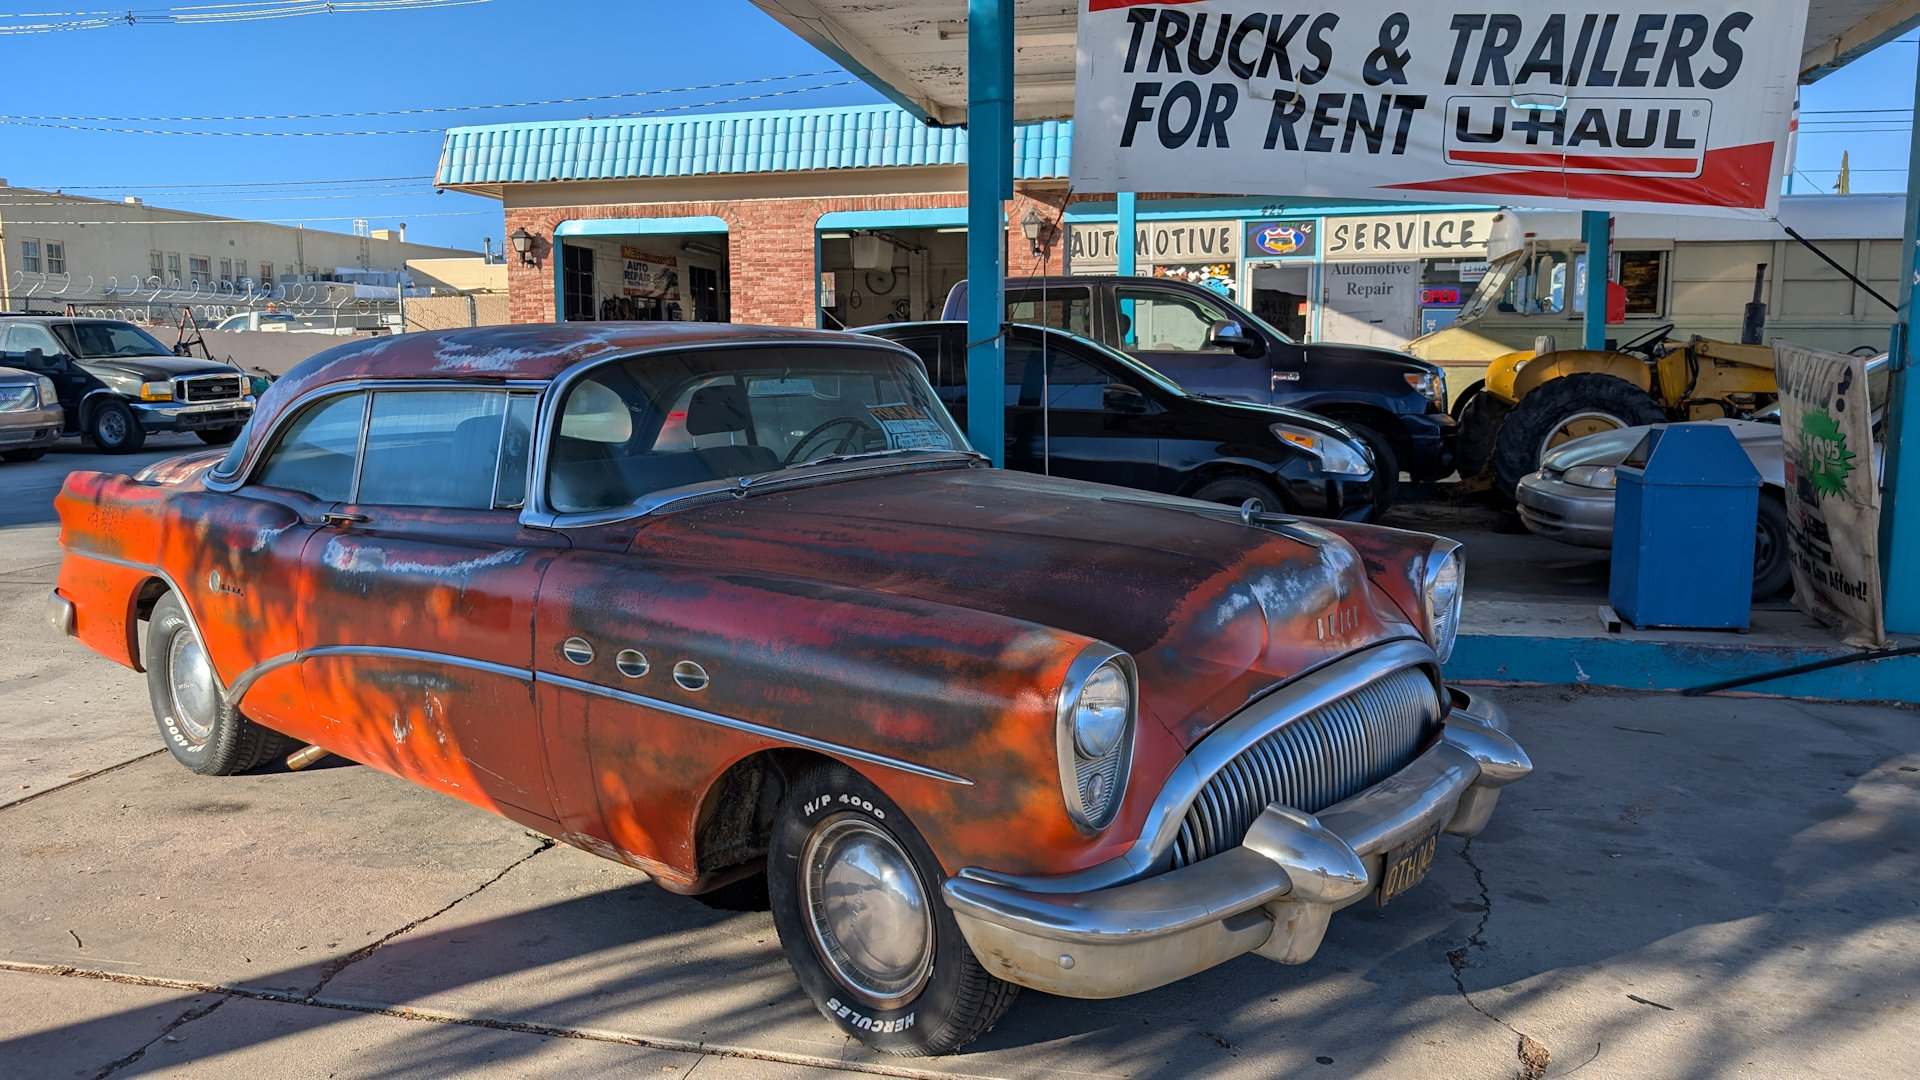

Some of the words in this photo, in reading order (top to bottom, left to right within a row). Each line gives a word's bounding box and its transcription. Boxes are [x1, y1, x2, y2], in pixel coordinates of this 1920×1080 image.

[1123, 8, 1340, 85] TRUCKS
[1363, 12, 1412, 86] &
[1444, 11, 1754, 89] TRAILERS
[1120, 80, 1239, 149] FOR
[1263, 89, 1428, 155] RENT
[1260, 204, 1285, 216] 425
[1300, 224, 1312, 233] 66
[1330, 220, 1475, 251] SERVICE
[627, 260, 649, 272] AUTO
[1331, 262, 1410, 275] Automotive
[624, 270, 650, 281] REPAIR
[1347, 282, 1394, 298] Repair
[1421, 289, 1459, 303] OPEN
[870, 407, 901, 419] FOR
[1829, 570, 1867, 603] Afford!
[164, 716, 189, 746] 4000
[804, 793, 832, 816] H/P
[838, 793, 886, 819] 4000
[827, 998, 915, 1033] HERCULES
